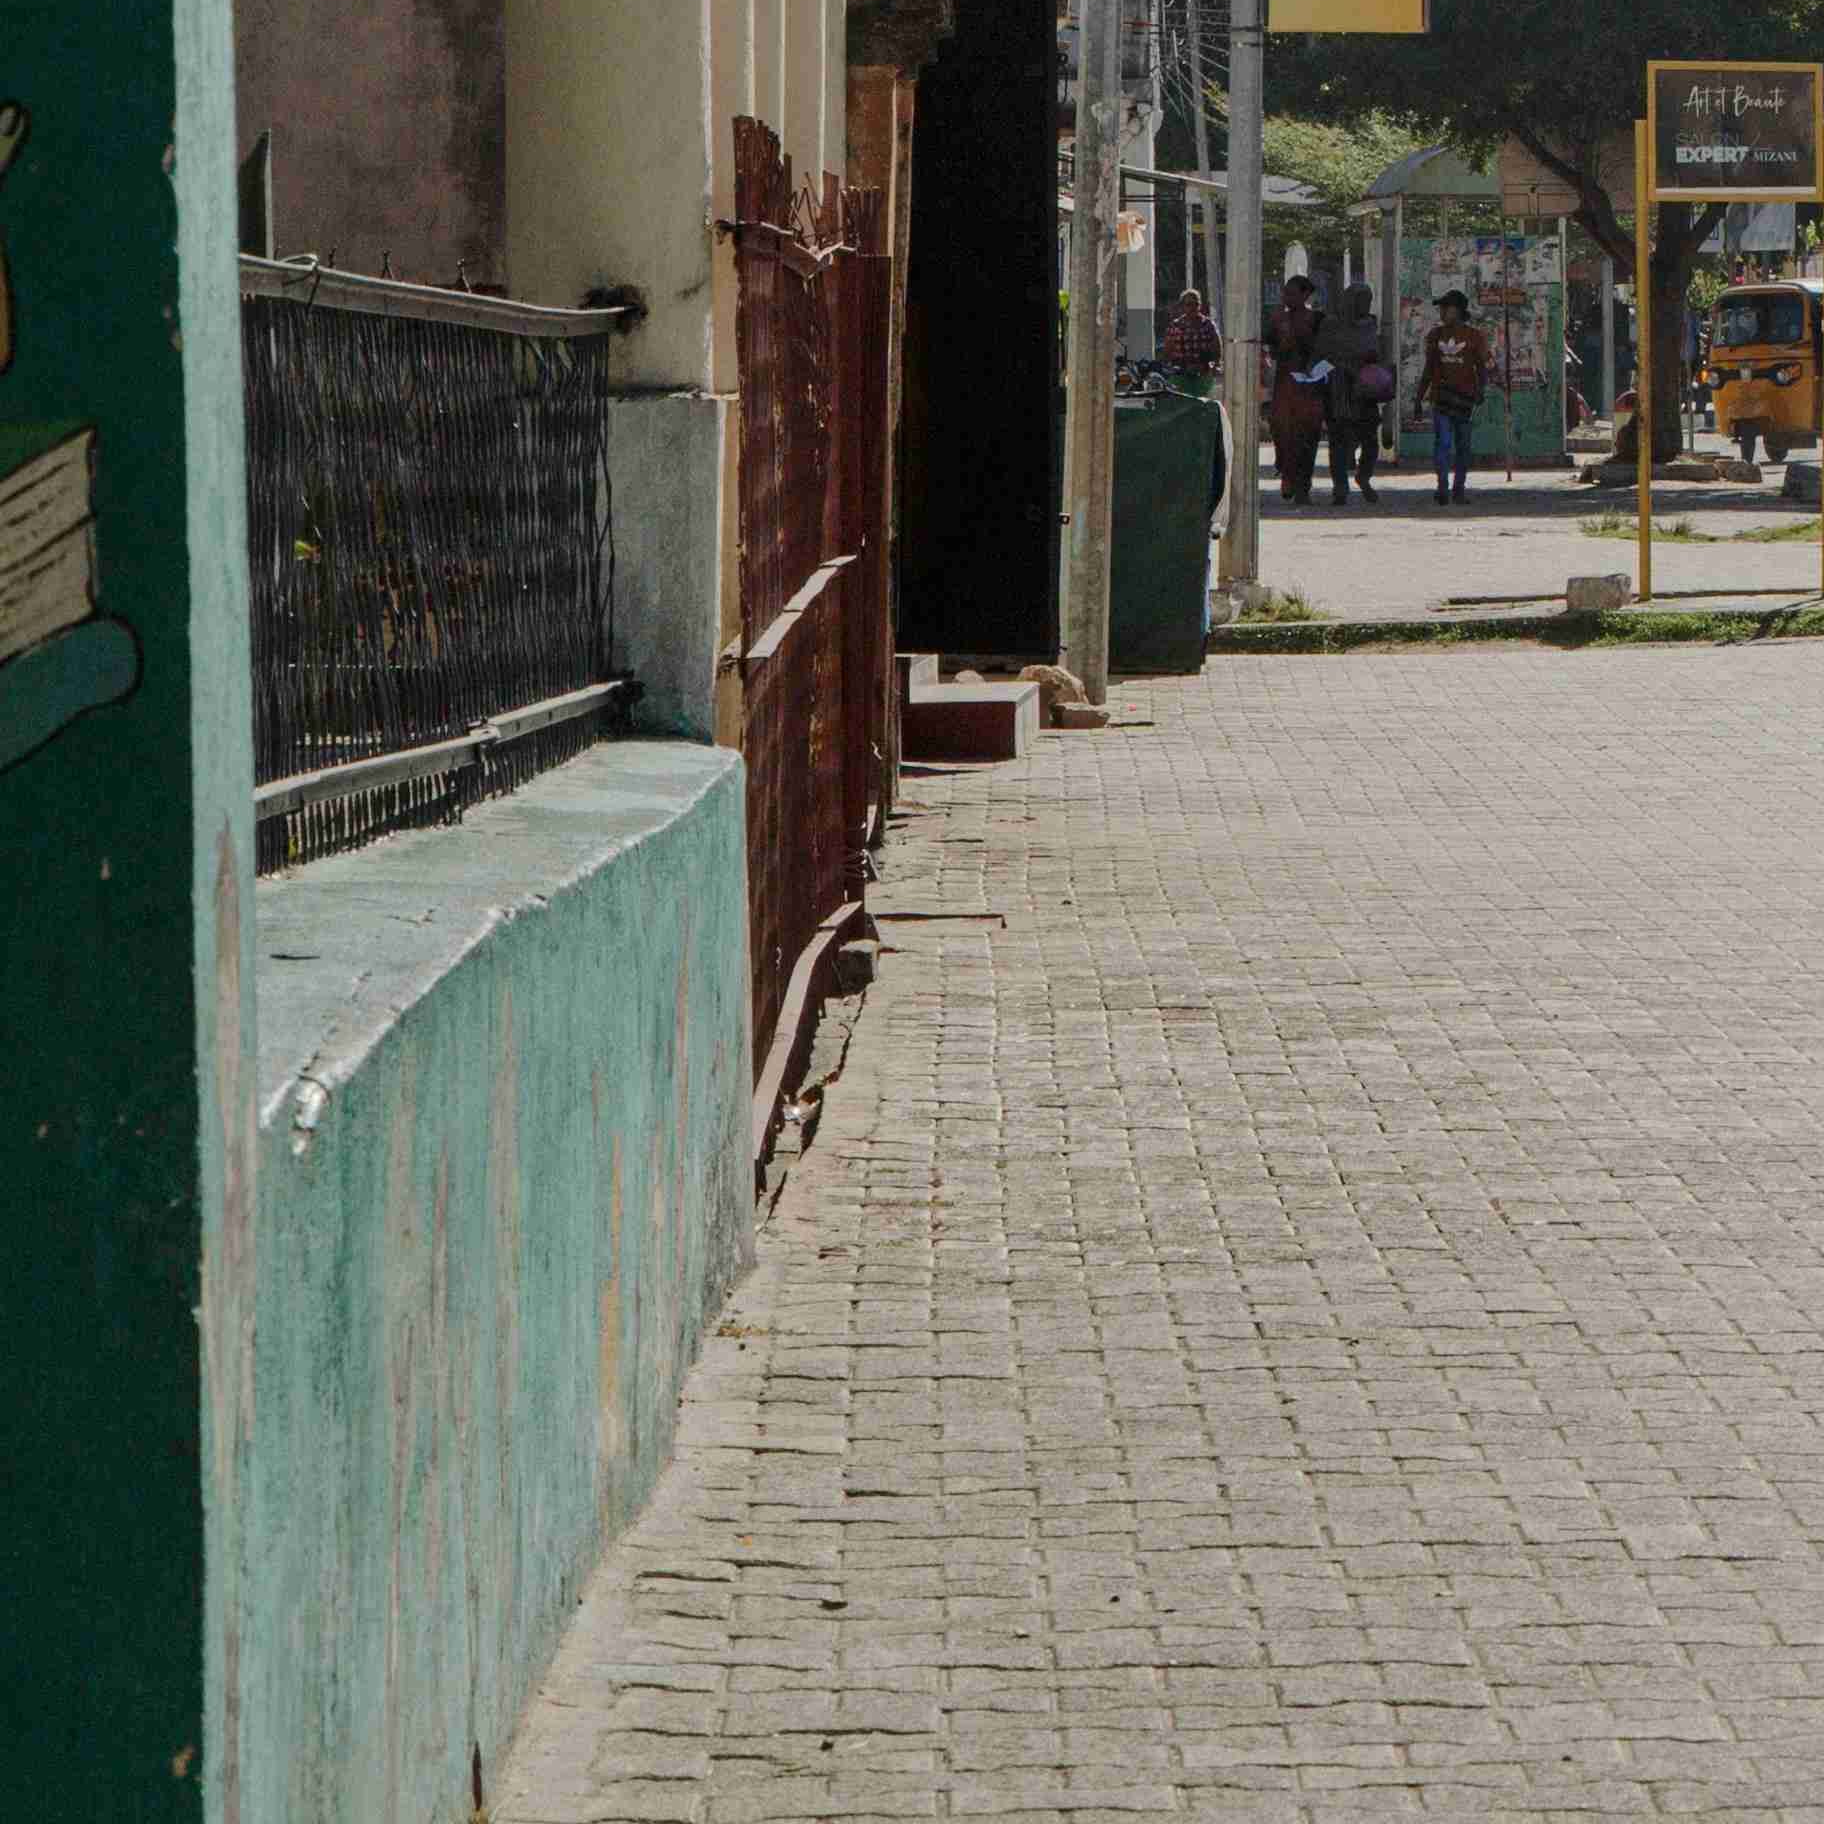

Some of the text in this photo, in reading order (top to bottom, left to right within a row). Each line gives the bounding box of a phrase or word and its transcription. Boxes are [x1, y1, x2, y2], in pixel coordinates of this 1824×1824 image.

[1683, 85, 1711, 118] Art
[1715, 87, 1732, 114] et
[1676, 146, 1798, 163] EXPERT MIZANI
